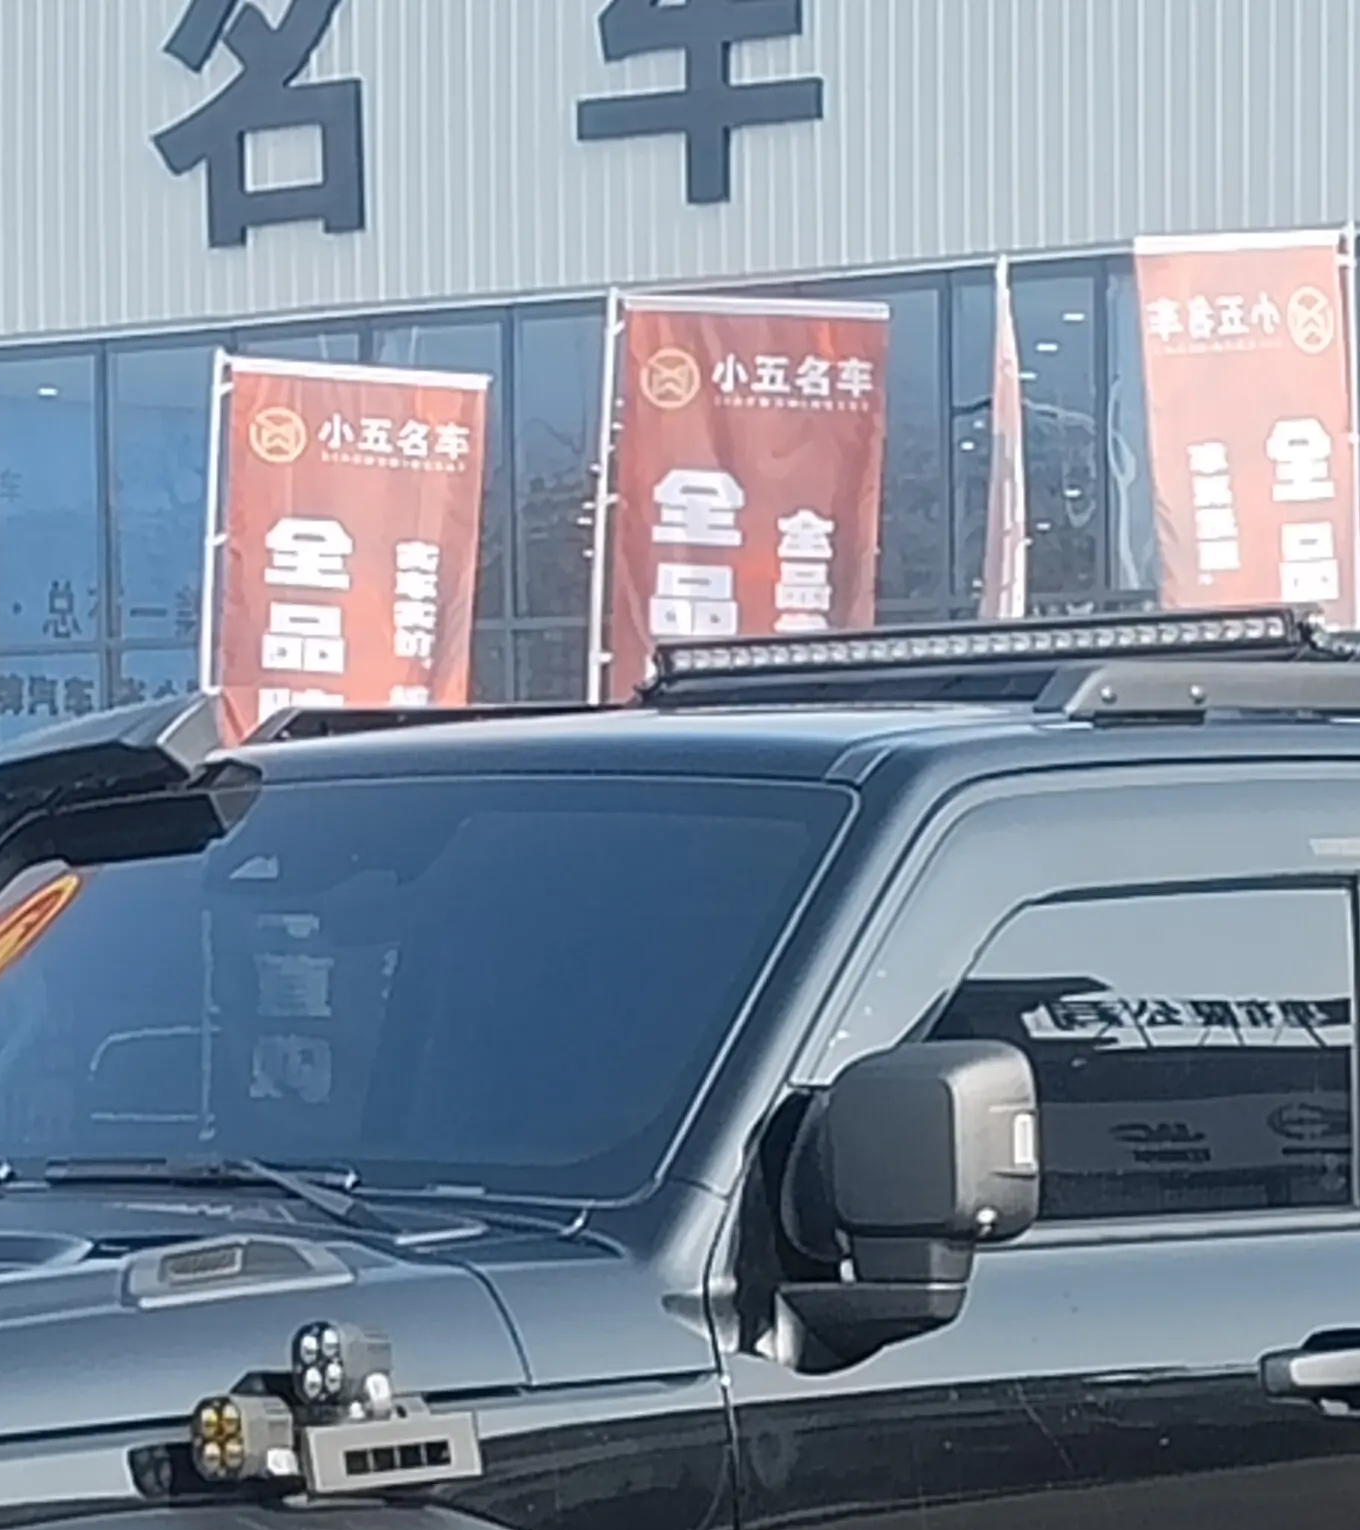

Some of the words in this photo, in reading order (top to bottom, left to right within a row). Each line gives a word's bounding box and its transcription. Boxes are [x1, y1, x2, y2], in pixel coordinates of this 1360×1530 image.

[711, 352, 874, 398] 小五名车
[317, 411, 470, 461] 小五名车
